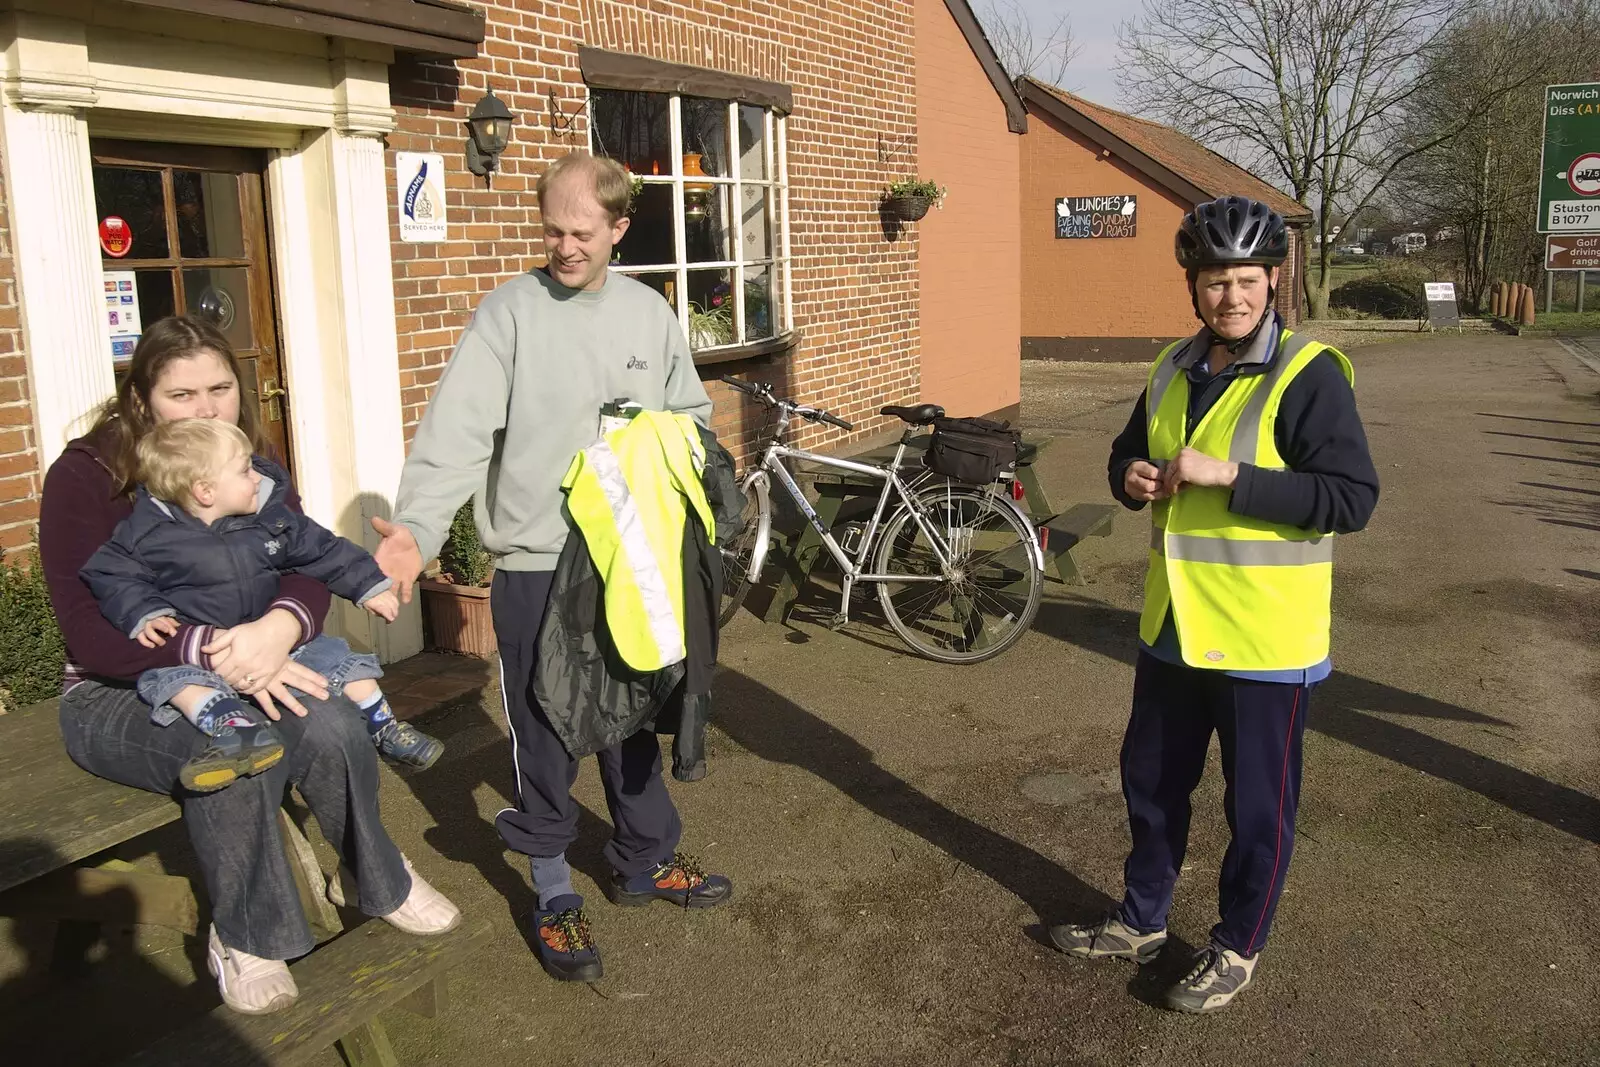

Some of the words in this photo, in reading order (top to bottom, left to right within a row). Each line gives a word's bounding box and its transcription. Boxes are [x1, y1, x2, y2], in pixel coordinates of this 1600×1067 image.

[1551, 89, 1599, 100] Norwich
[1550, 106, 1575, 115] Diss
[1076, 196, 1120, 211] LUNCHES
[1554, 204, 1600, 212] Stuston
[1058, 214, 1091, 227] EVENING
[1091, 212, 1133, 237] SUNDAY
[1061, 226, 1089, 237] MEALS
[1107, 224, 1136, 237] ROAST
[1570, 248, 1600, 257] driving
